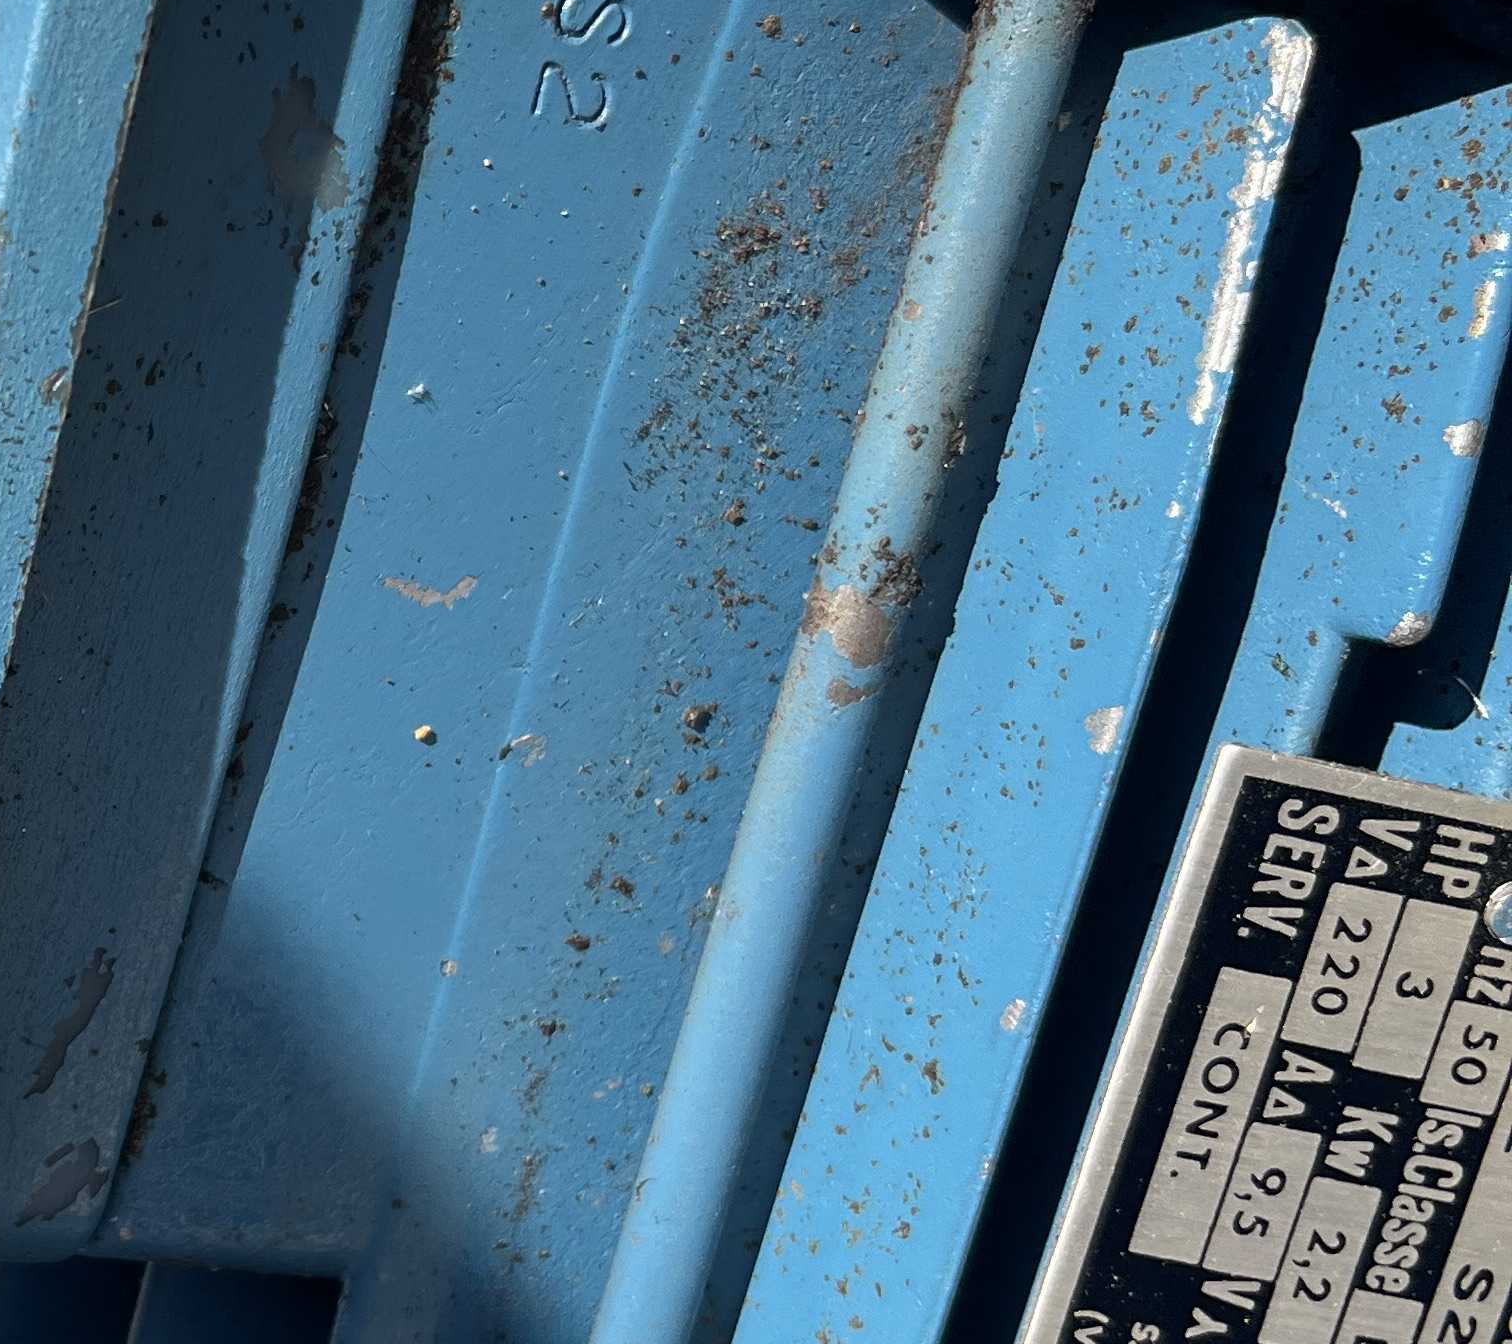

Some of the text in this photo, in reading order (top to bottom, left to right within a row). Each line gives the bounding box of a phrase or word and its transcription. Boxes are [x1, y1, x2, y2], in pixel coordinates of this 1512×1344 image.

[1310, 915, 1373, 1016] 220
[1395, 824, 1496, 1000] HP 3
[1169, 798, 1340, 1178] SERV. CONT.
[1450, 1024, 1499, 1086] 50
[1232, 1166, 1288, 1239] 9,5
[1292, 1106, 1400, 1303] Kw 2,2
